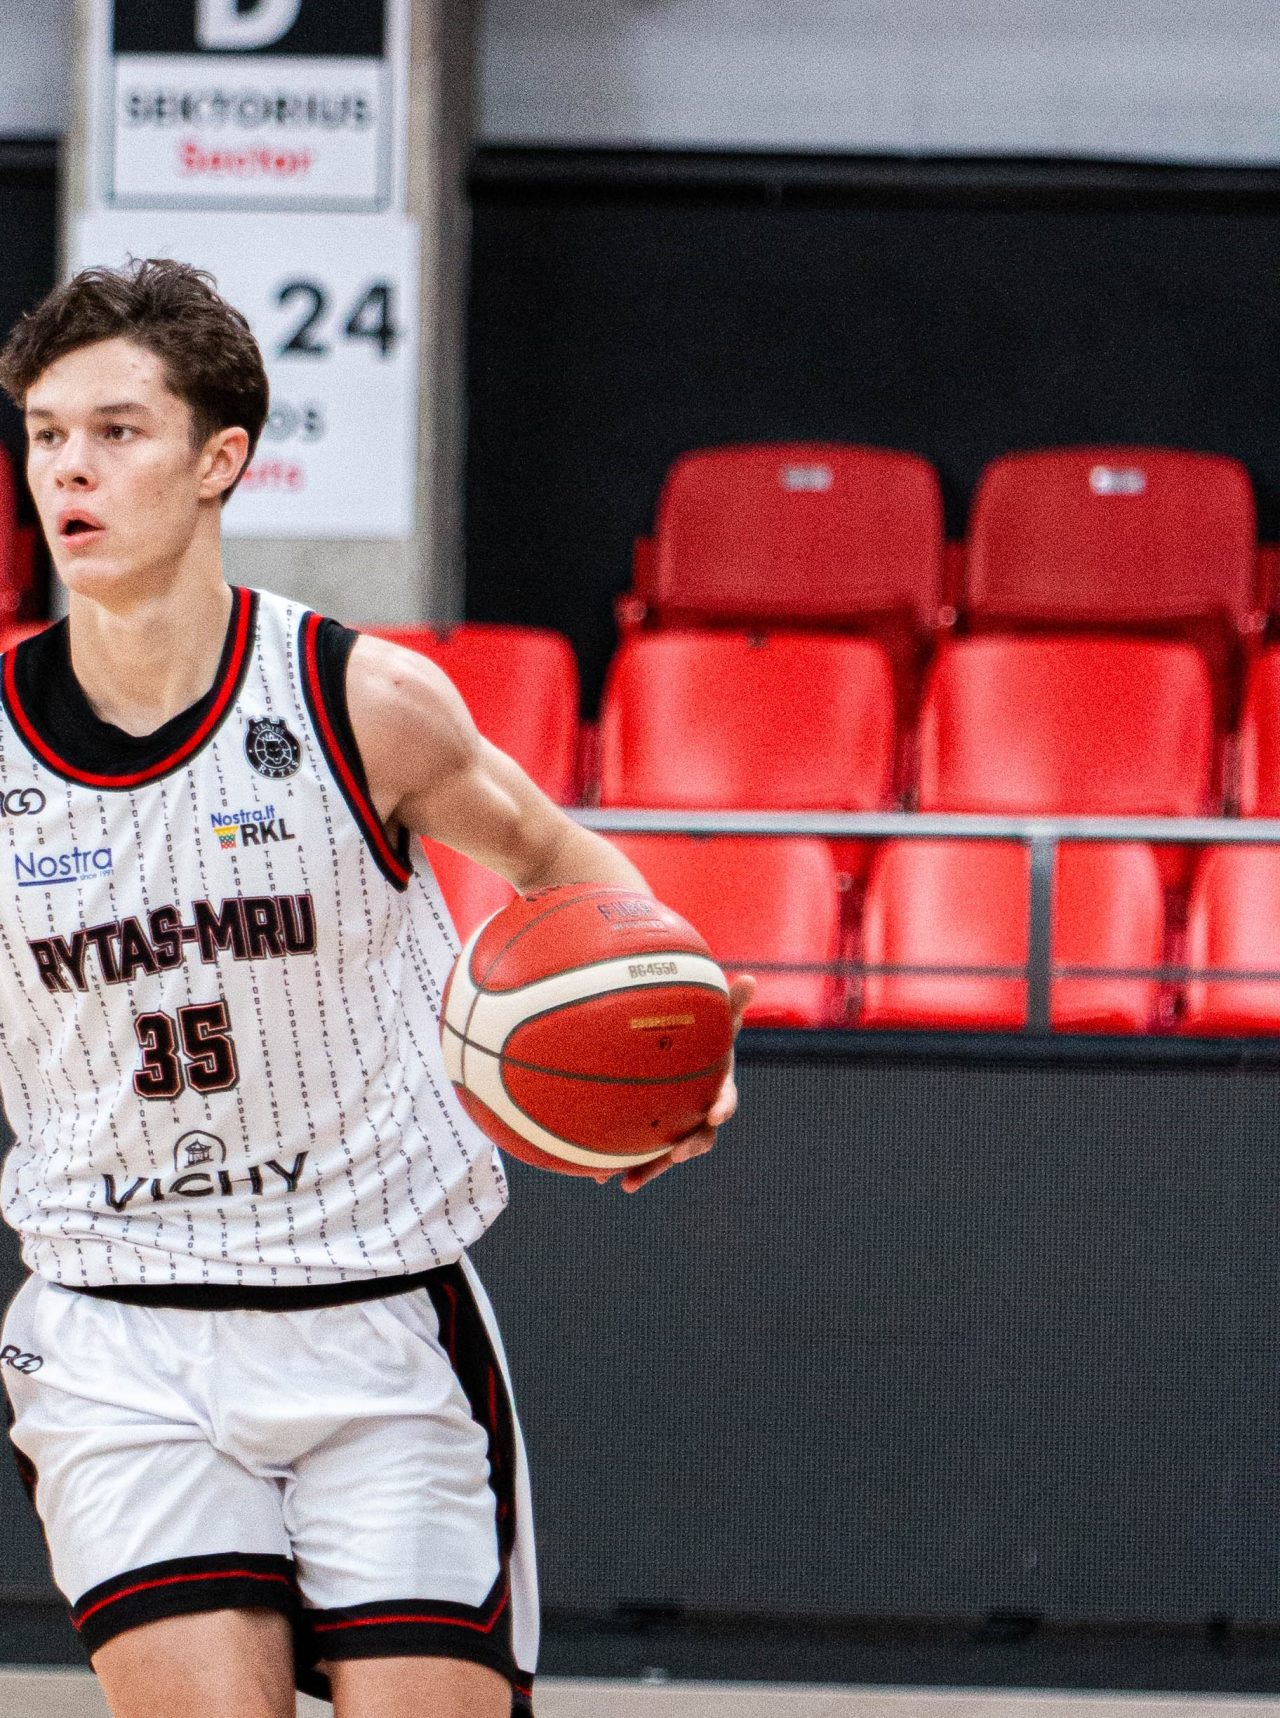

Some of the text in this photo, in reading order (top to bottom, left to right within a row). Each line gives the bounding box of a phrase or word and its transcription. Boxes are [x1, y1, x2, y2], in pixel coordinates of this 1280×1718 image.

[122, 91, 371, 128] SEKTORIUS
[274, 277, 398, 356] 24
[258, 760, 299, 776] RYTAS
[210, 804, 275, 828] Nostra.lt
[240, 818, 295, 847] RKL
[14, 846, 113, 880] Nostra
[27, 894, 317, 993] RYTAS-MRU
[628, 961, 678, 979] BG4550
[133, 1000, 239, 1101] 35
[102, 1150, 309, 1213] VICHY
